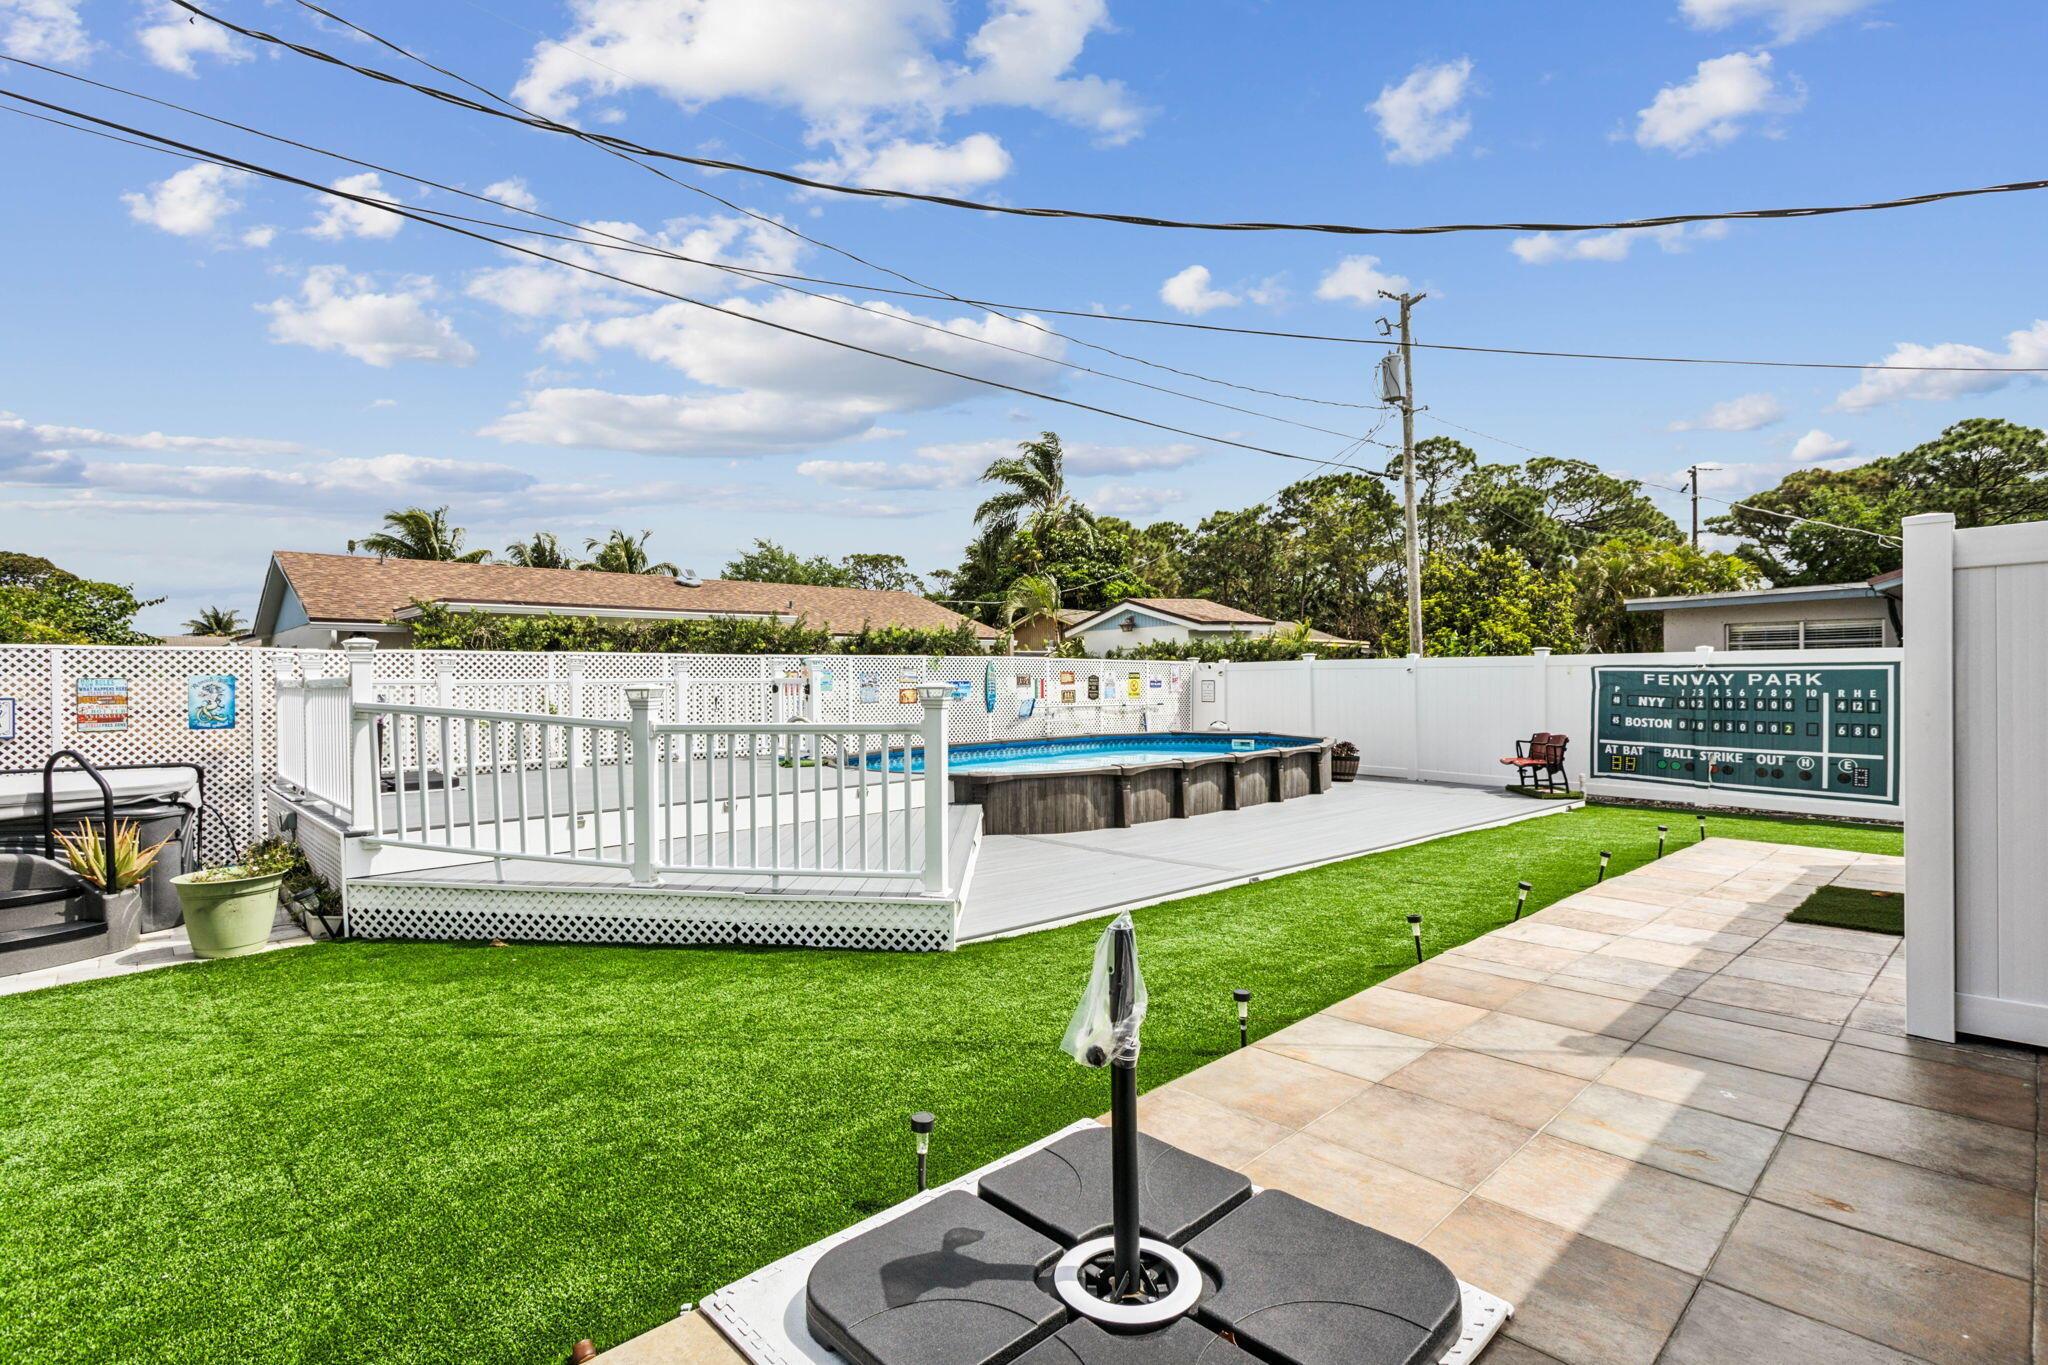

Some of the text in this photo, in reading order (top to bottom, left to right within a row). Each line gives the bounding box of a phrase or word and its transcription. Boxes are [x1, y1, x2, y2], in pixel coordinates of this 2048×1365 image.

[1748, 673, 1823, 686] PARK
[1698, 688, 1704, 696] 3
[1713, 689, 1719, 697] 4
[1726, 689, 1732, 697] 5
[1739, 689, 1745, 697] 6
[1757, 689, 1763, 697] 7
[1771, 689, 1777, 697] 8
[1785, 689, 1792, 697] 9
[1806, 689, 1817, 697] 10
[1838, 689, 1877, 698] R H E
[1638, 696, 1666, 707] NYY
[1697, 700, 1704, 708] 2
[1714, 700, 1720, 708] 0
[1726, 700, 1733, 708] 0
[1740, 700, 1746, 708] 2
[1757, 701, 1763, 709] 0
[1771, 701, 1777, 709] 0
[1785, 701, 1792, 709] 0
[1837, 702, 1845, 710] 4
[1852, 702, 1863, 711] 12
[1625, 717, 1672, 728] BOSTON
[1697, 722, 1704, 730] 0
[1740, 723, 1746, 731] 0
[1757, 724, 1763, 732] 0
[1771, 724, 1777, 732] 0
[1785, 725, 1792, 733] 2
[1838, 727, 1878, 736] 6 8 0
[1605, 744, 1618, 754] AT
[1623, 746, 1645, 755] BAT
[1663, 748, 1694, 759] BALL
[1700, 751, 1743, 763] STRIKE
[1756, 754, 1786, 766] OUT
